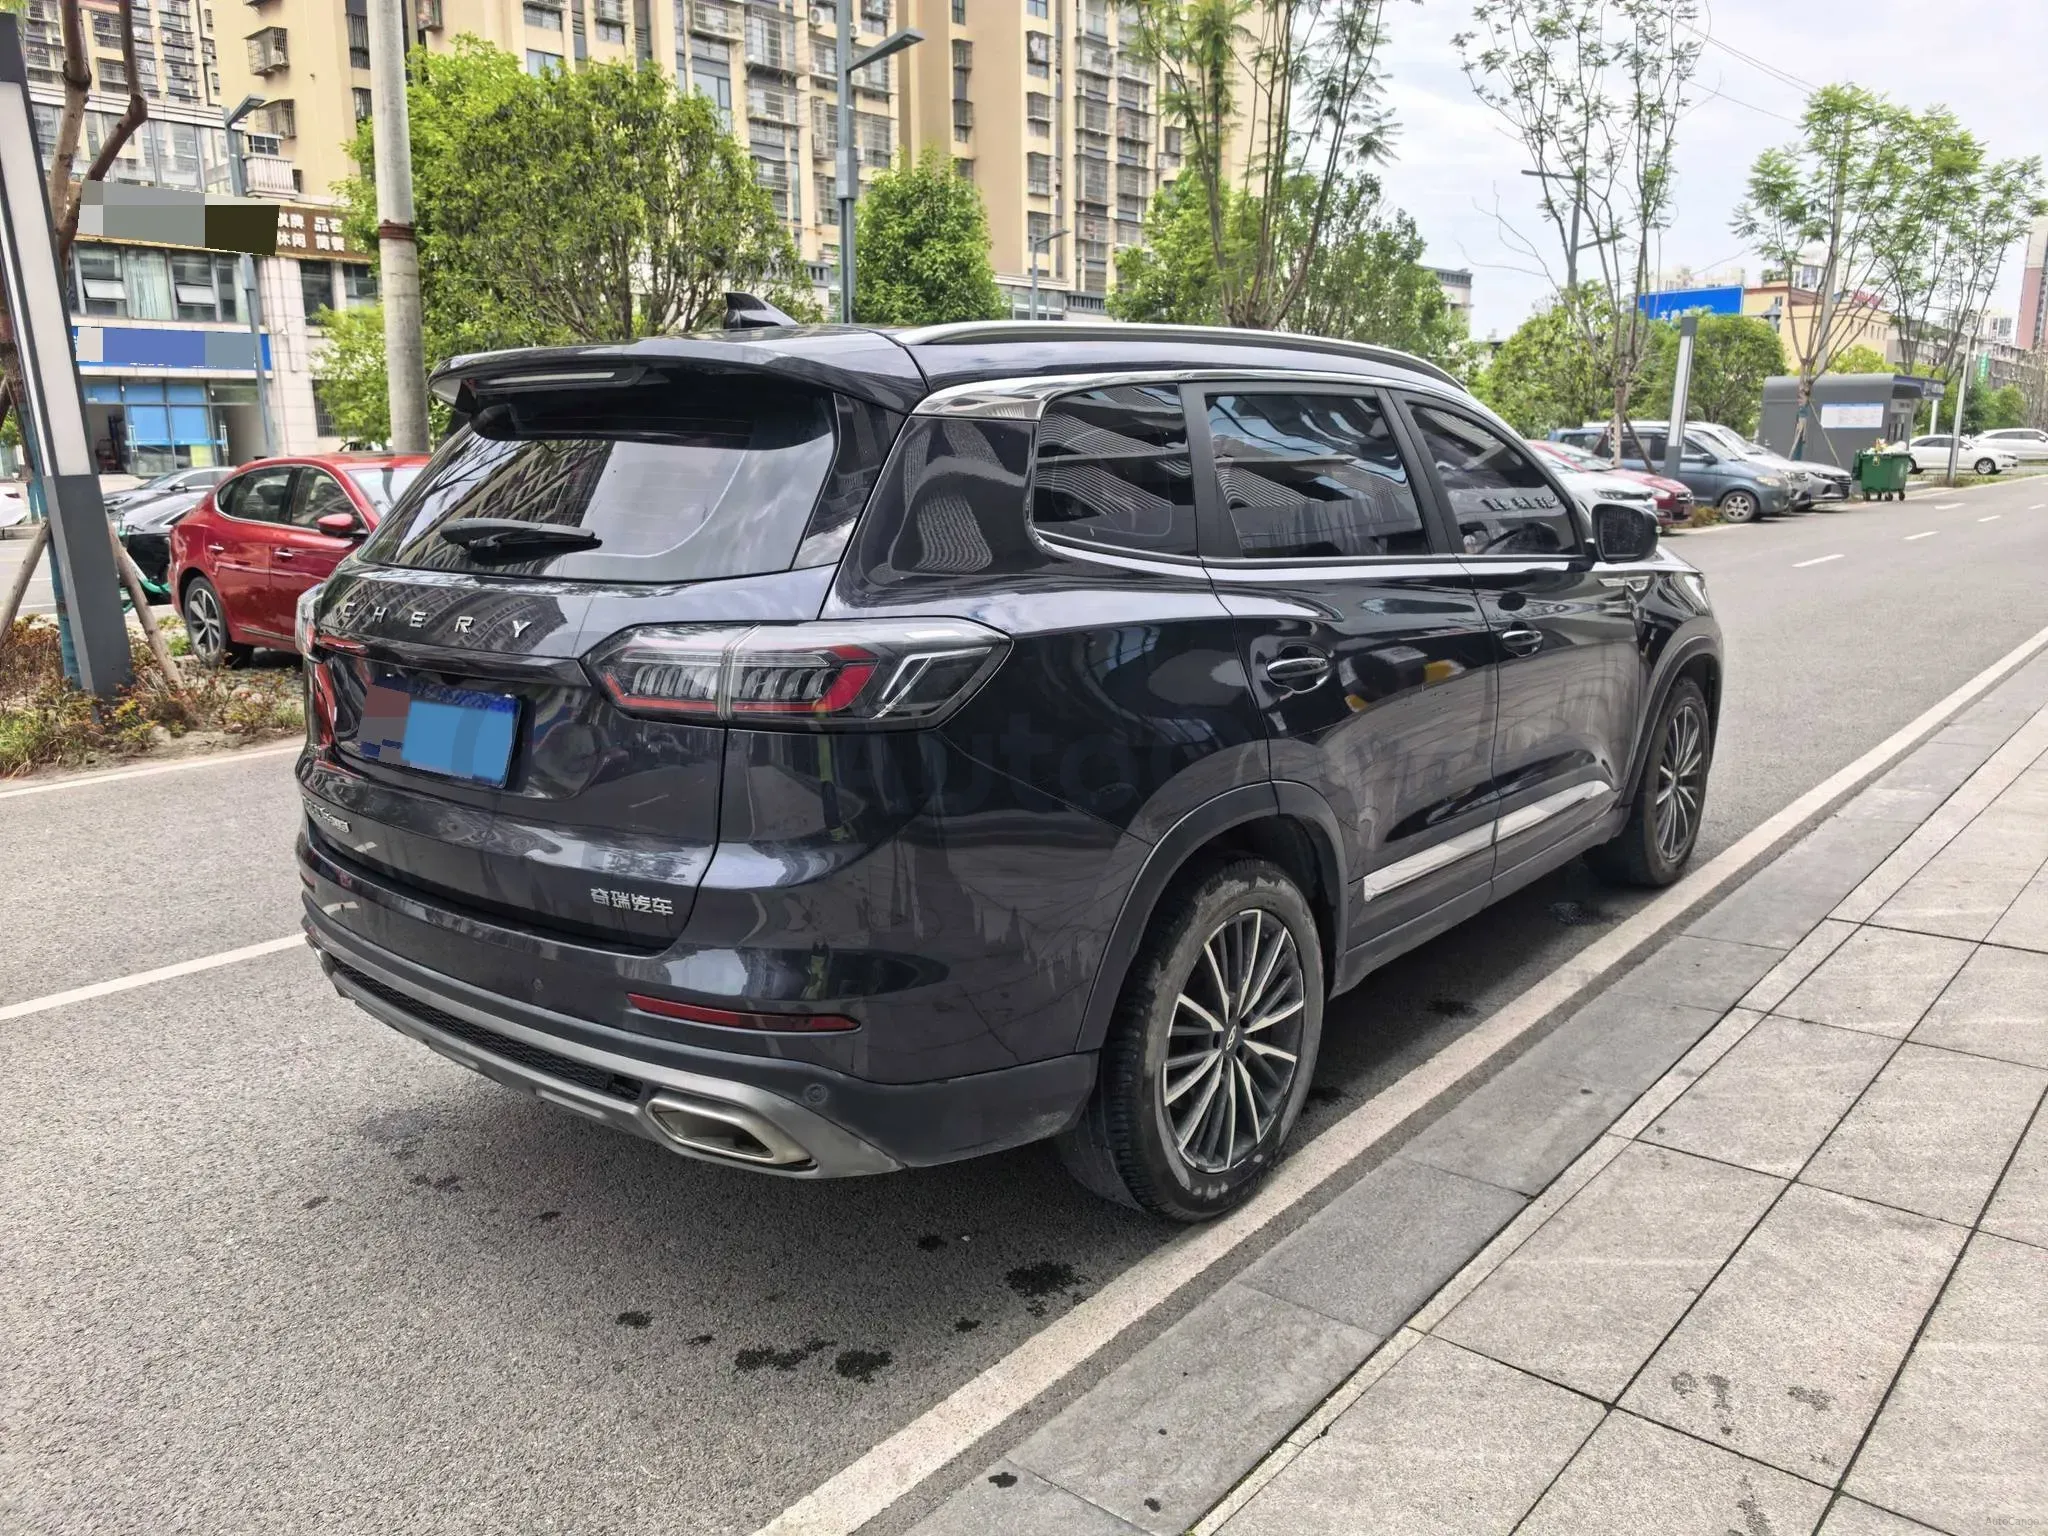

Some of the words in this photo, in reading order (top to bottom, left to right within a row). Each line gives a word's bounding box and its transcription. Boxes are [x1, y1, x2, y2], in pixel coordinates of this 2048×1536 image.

[342, 602, 532, 639] CHERY
[590, 888, 674, 916] 奇瑞汽车
